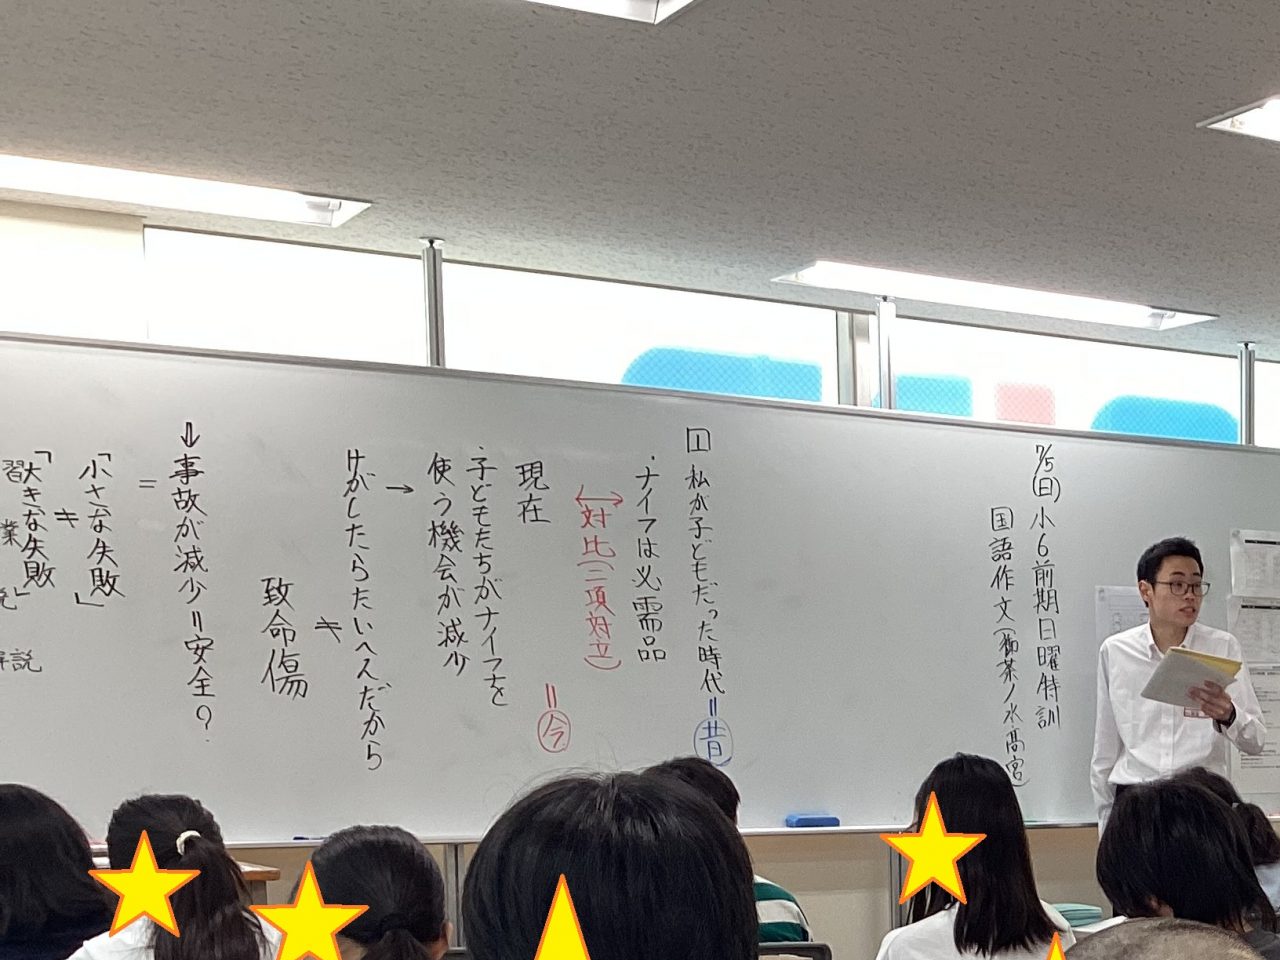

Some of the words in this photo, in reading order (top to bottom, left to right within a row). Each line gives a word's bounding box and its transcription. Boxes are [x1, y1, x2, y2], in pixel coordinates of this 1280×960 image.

[427, 451, 471, 676] 使う機会が減少
[515, 461, 552, 524] 現在
[685, 465, 726, 695] 私が子どもだった時代
[260, 576, 308, 700] 致命傷
[343, 449, 392, 770] けがしたらたいへんだから
